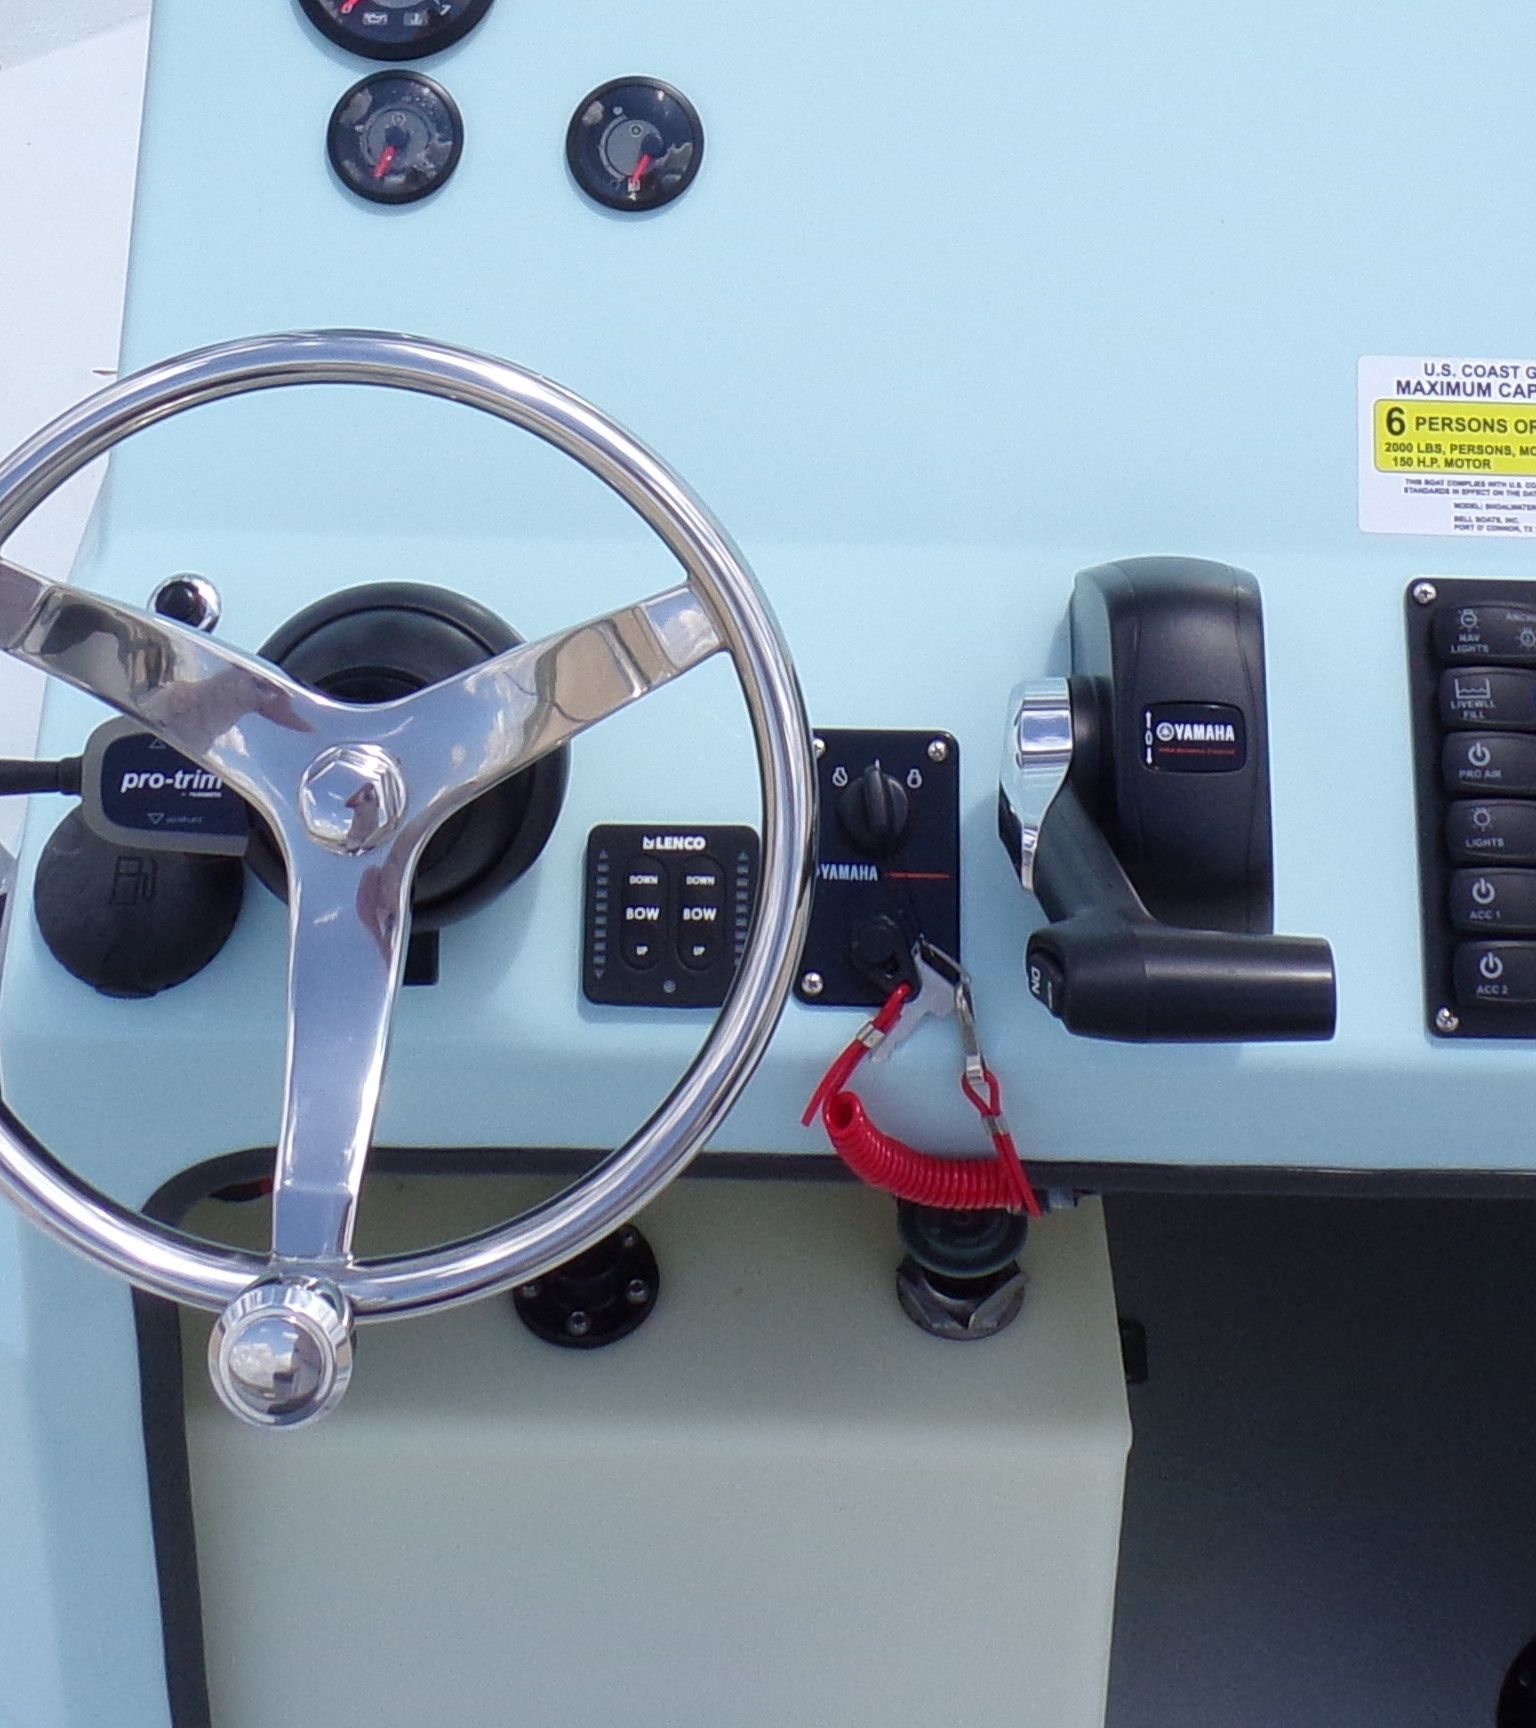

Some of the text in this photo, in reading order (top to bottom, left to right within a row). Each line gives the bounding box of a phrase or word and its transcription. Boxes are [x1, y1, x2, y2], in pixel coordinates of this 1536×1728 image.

[1424, 363, 1456, 377] U.S.
[1461, 364, 1521, 380] COAST
[1396, 379, 1492, 398] MAXIMUM
[1386, 406, 1406, 436] 6
[1415, 416, 1508, 434] PERSONS
[1384, 442, 1414, 453] 2000
[1417, 443, 1446, 455] LBS,
[1450, 444, 1516, 458] PERSONS,
[1392, 456, 1413, 467] 150
[1445, 458, 1492, 469] MOTOR
[1450, 643, 1489, 654] LIGHTS
[1174, 723, 1235, 742] YAMAHA
[1458, 769, 1482, 778] PRO
[120, 769, 224, 793] pro-trim
[655, 835, 707, 851] LENCO
[1465, 838, 1505, 848] LIGHTS
[820, 863, 879, 882] YAMAHA
[629, 875, 659, 885] DOWN
[686, 875, 716, 886] DOWN
[626, 907, 660, 920] BOW
[682, 907, 717, 920] BOW
[1470, 910, 1493, 919] ACC
[1031, 966, 1041, 995] DN
[1477, 985, 1499, 995] ACC
